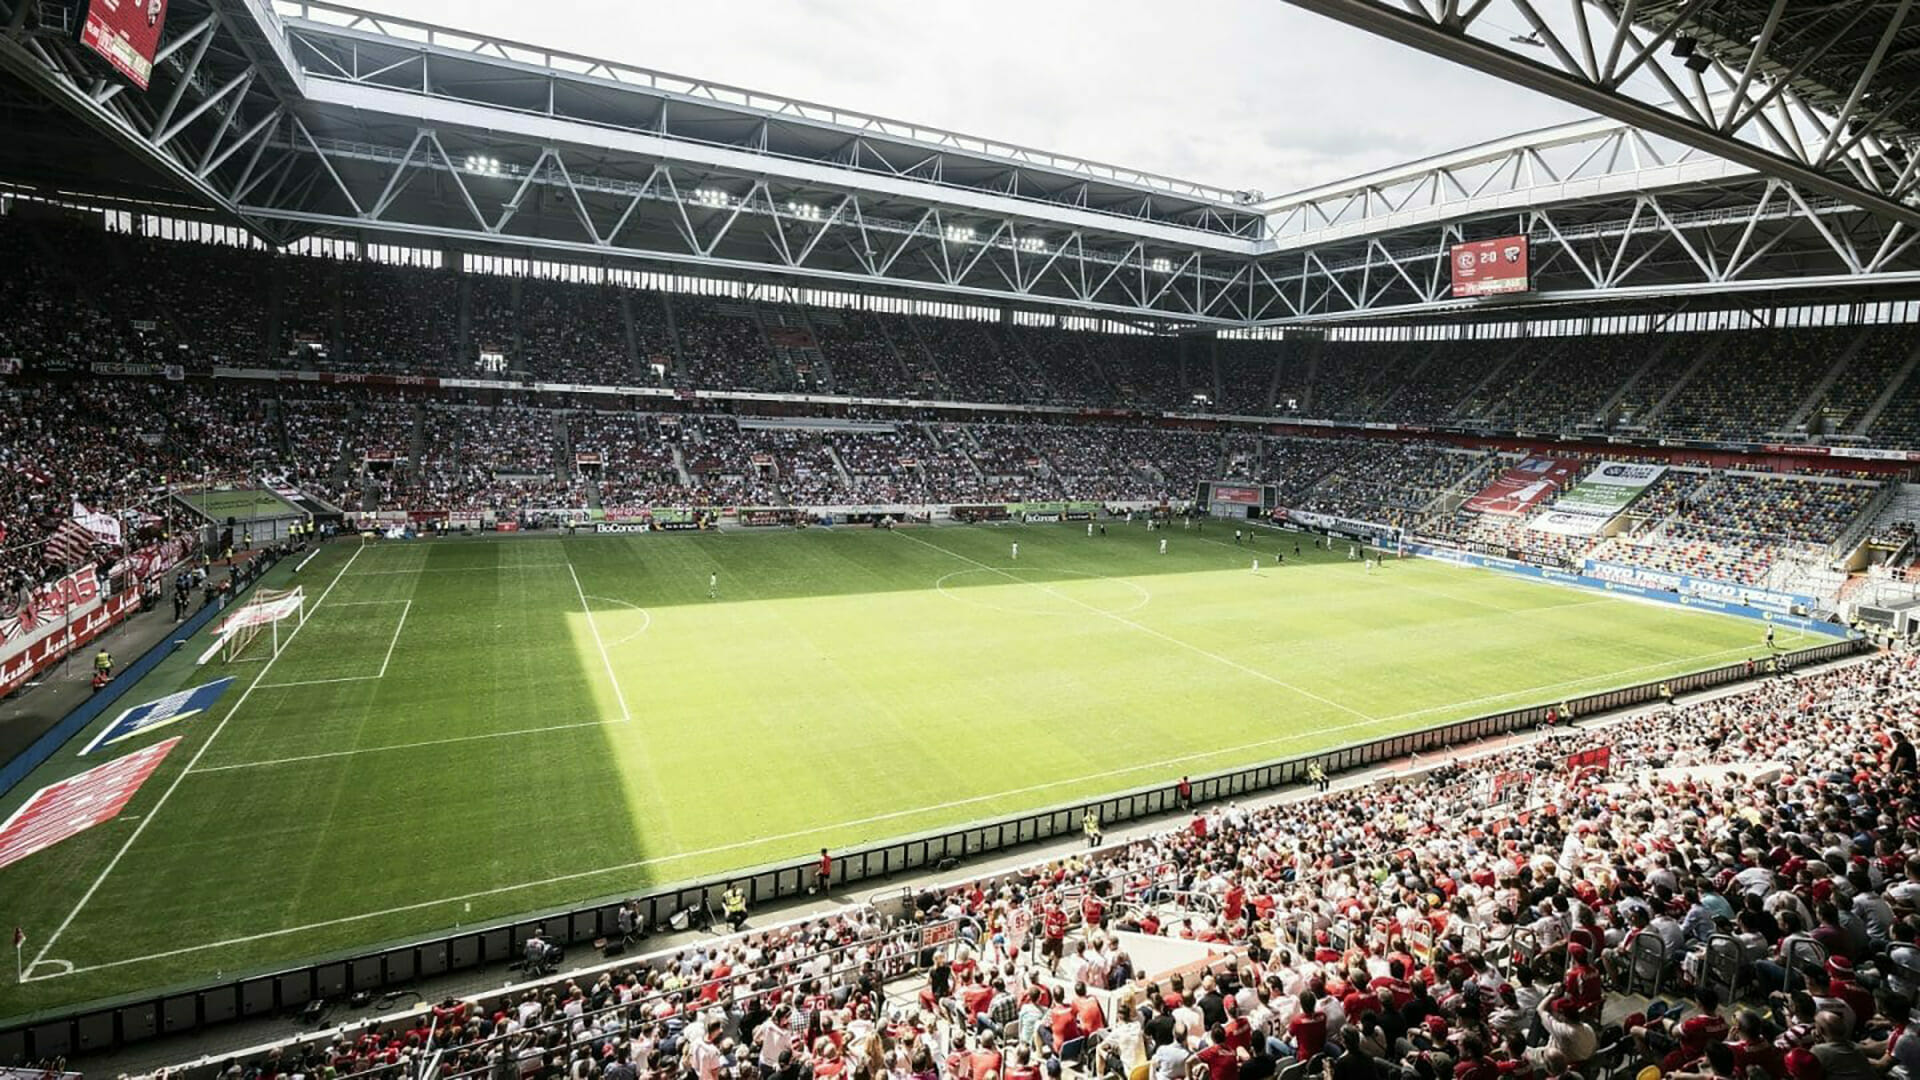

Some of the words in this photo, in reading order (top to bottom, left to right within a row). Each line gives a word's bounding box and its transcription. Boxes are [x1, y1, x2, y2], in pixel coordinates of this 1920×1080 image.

[597, 523, 650, 533] BoConcept
[1594, 563, 1633, 577] TOYO
[1635, 569, 1681, 585] TIRES
[1688, 580, 1736, 596] TOYO
[1738, 588, 1794, 604] TIRES
